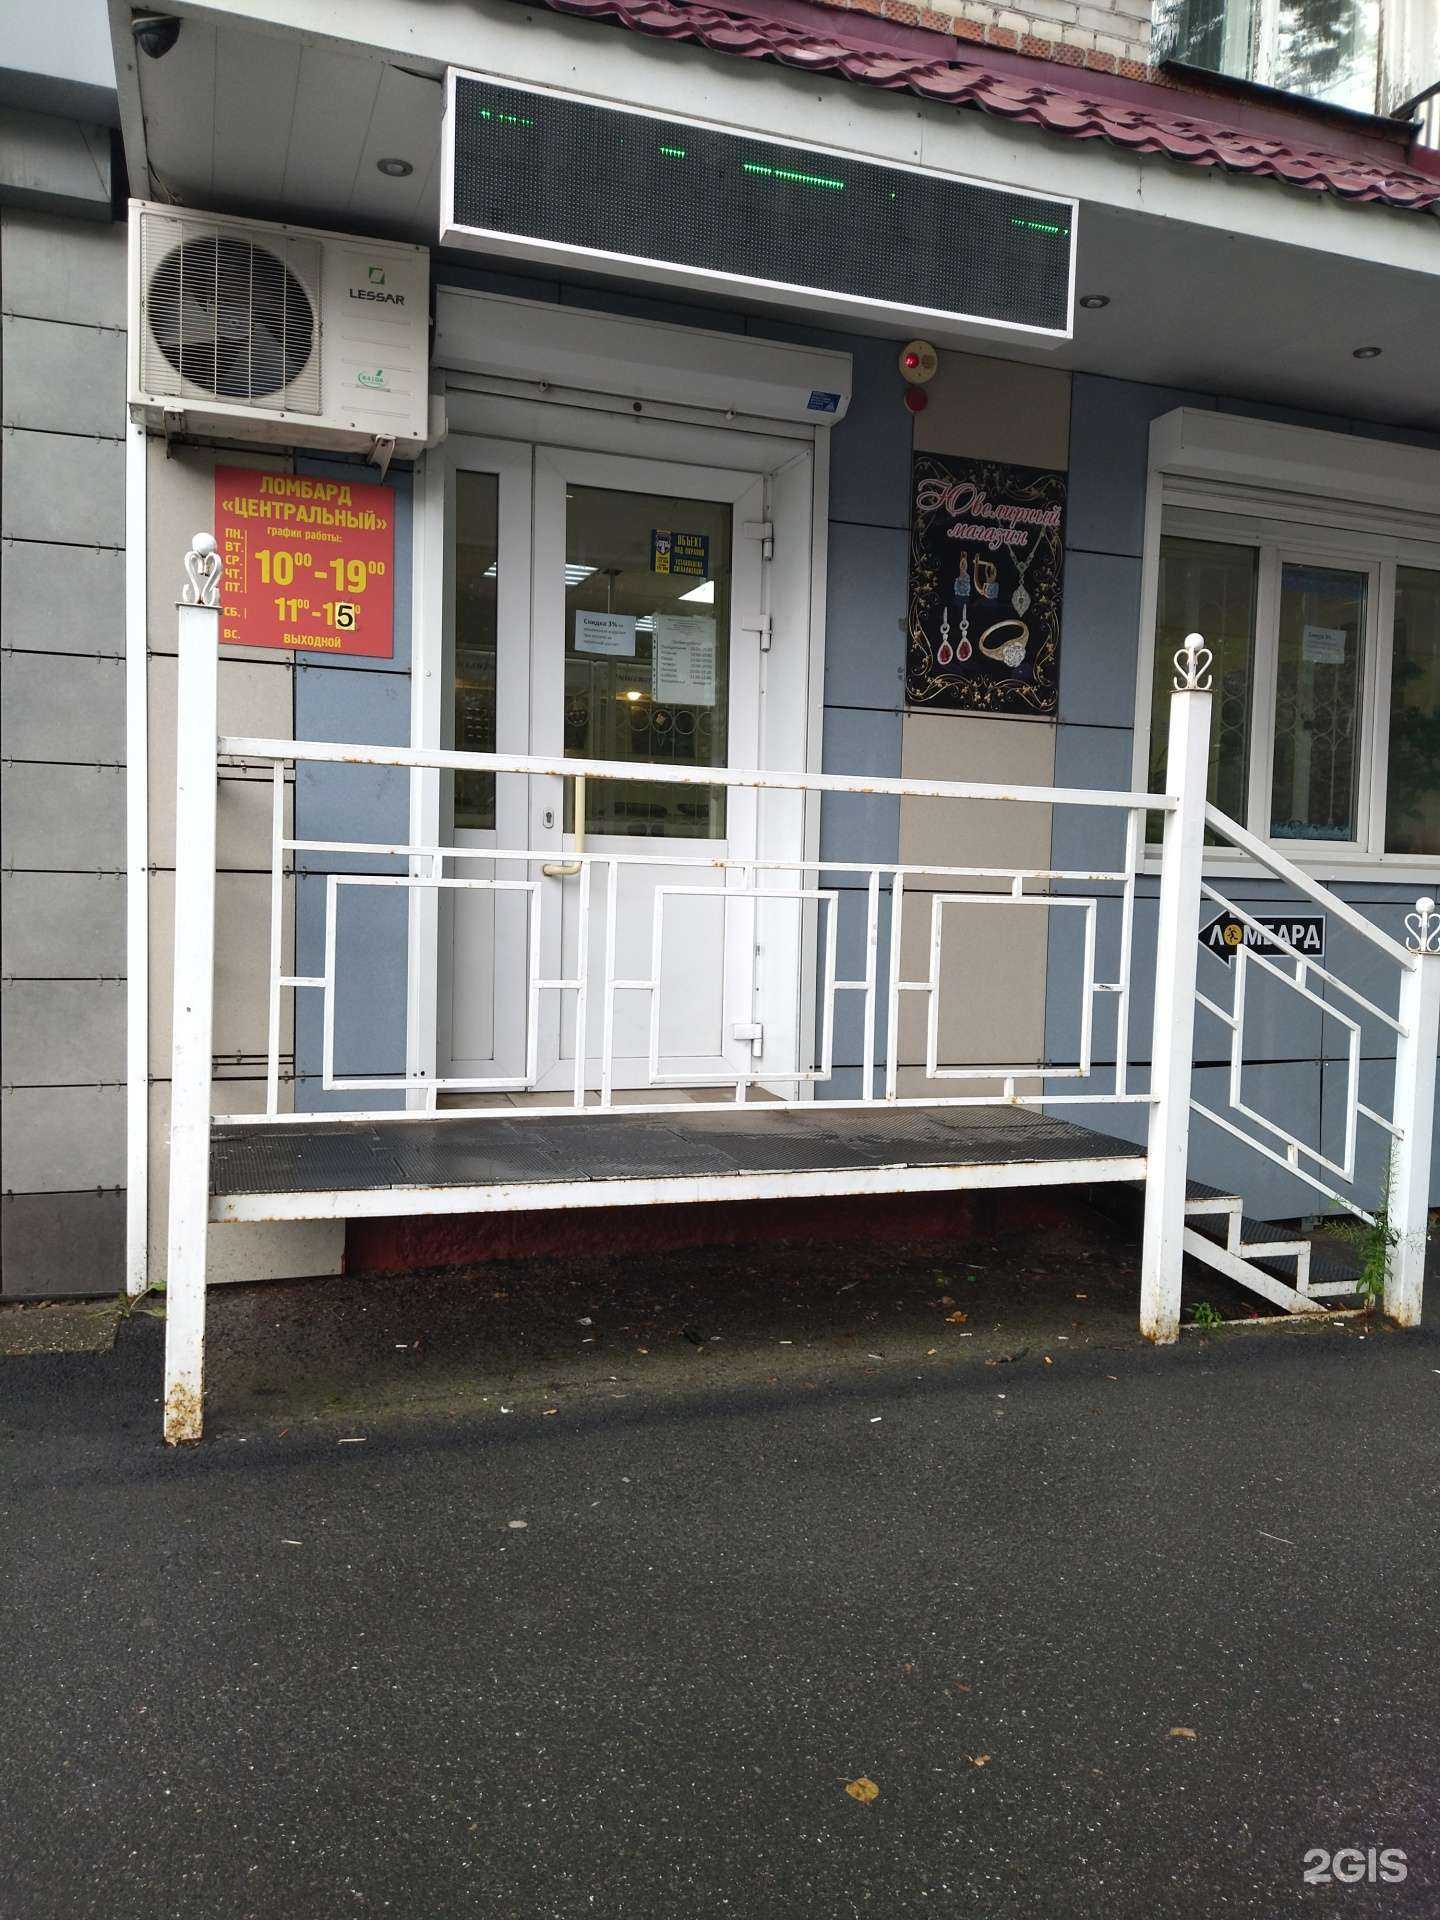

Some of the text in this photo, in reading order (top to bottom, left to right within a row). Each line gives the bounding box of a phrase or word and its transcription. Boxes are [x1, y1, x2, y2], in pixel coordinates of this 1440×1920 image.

[349, 288, 405, 305] LESSAR
[259, 476, 352, 507] ЛОМБАРД
[916, 478, 1061, 527] Ювелирный
[222, 496, 388, 531] «ЦЕНТРАЛЬНЫЙ»
[224, 528, 244, 540] ПН.
[267, 526, 343, 543] график работы:
[947, 523, 1028, 550] магазин
[224, 541, 244, 553] ВТ.
[224, 554, 243, 566] СР.
[224, 568, 243, 580] ЧТ.
[224, 581, 244, 593] ПТ.
[223, 606, 241, 617] СБ.
[223, 628, 241, 640] ВС.
[283, 633, 342, 648] ВЫХОДНОЙ
